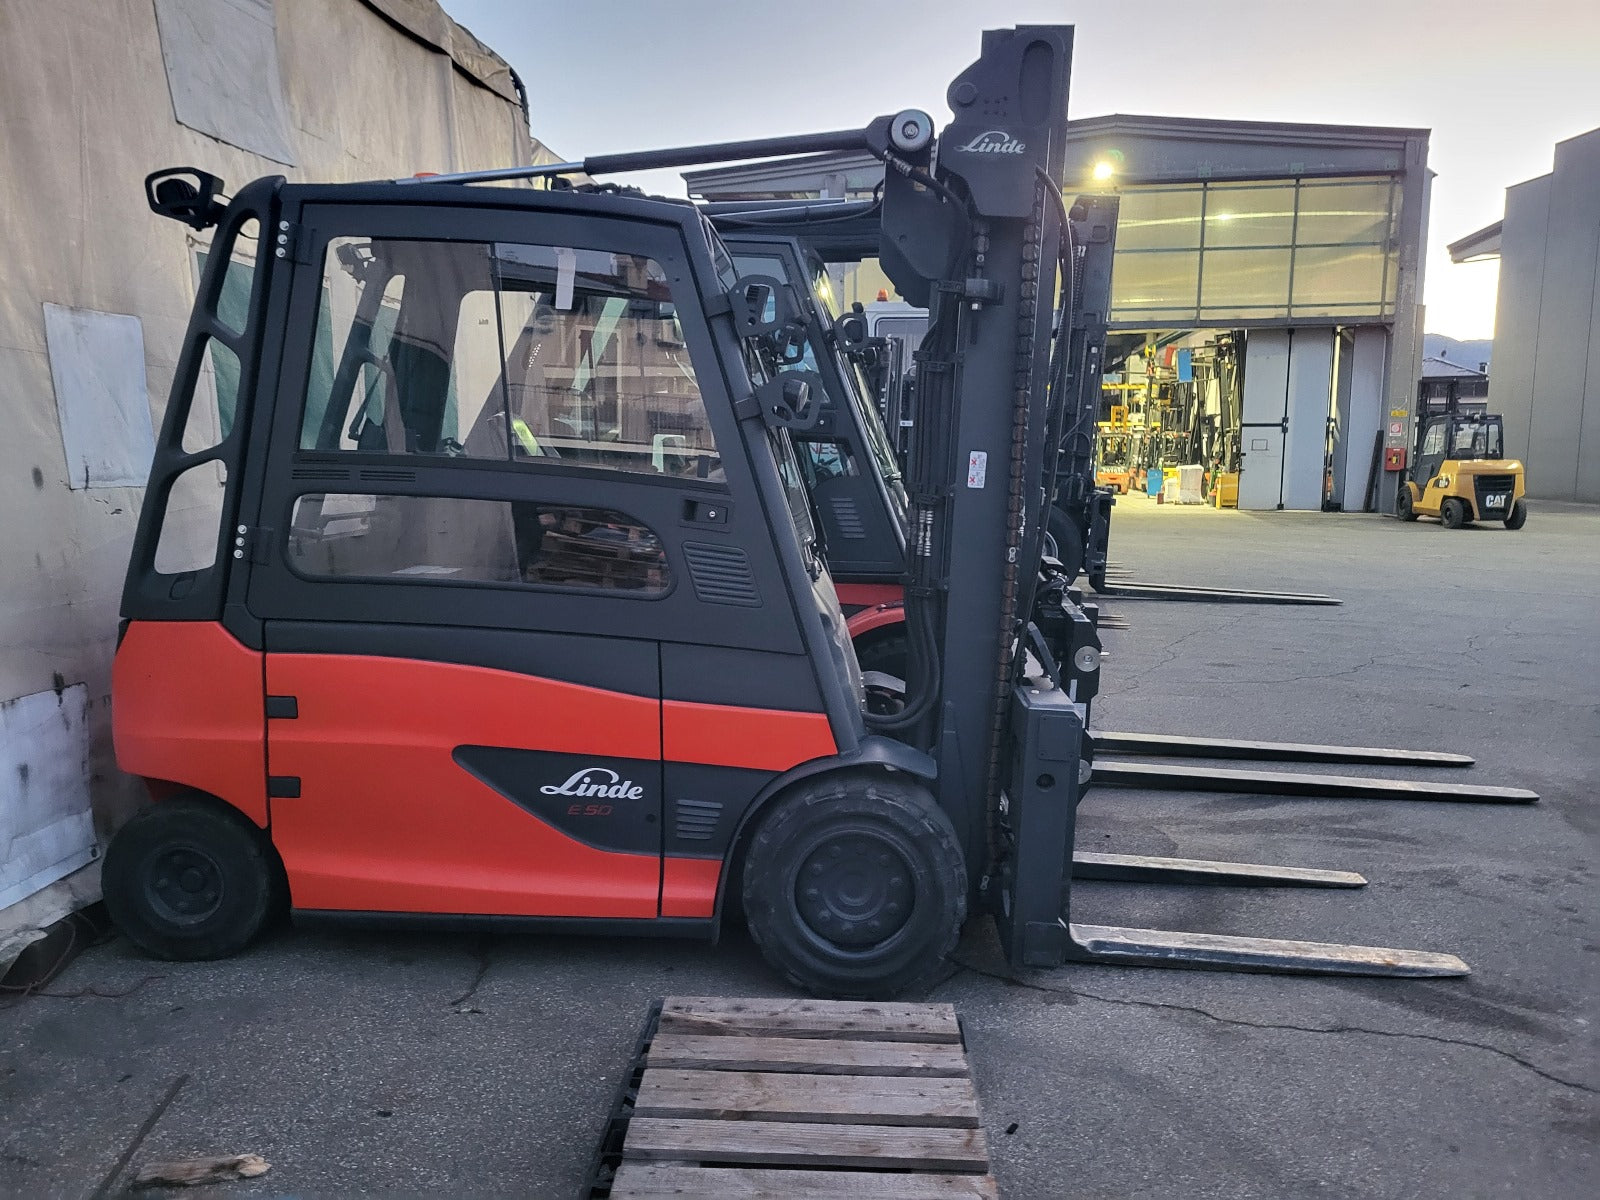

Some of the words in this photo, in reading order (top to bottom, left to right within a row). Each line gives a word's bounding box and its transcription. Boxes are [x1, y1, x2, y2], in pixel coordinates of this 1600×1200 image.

[953, 131, 1026, 154] Linde
[1485, 494, 1506, 508] CAT
[540, 767, 643, 800] Linde
